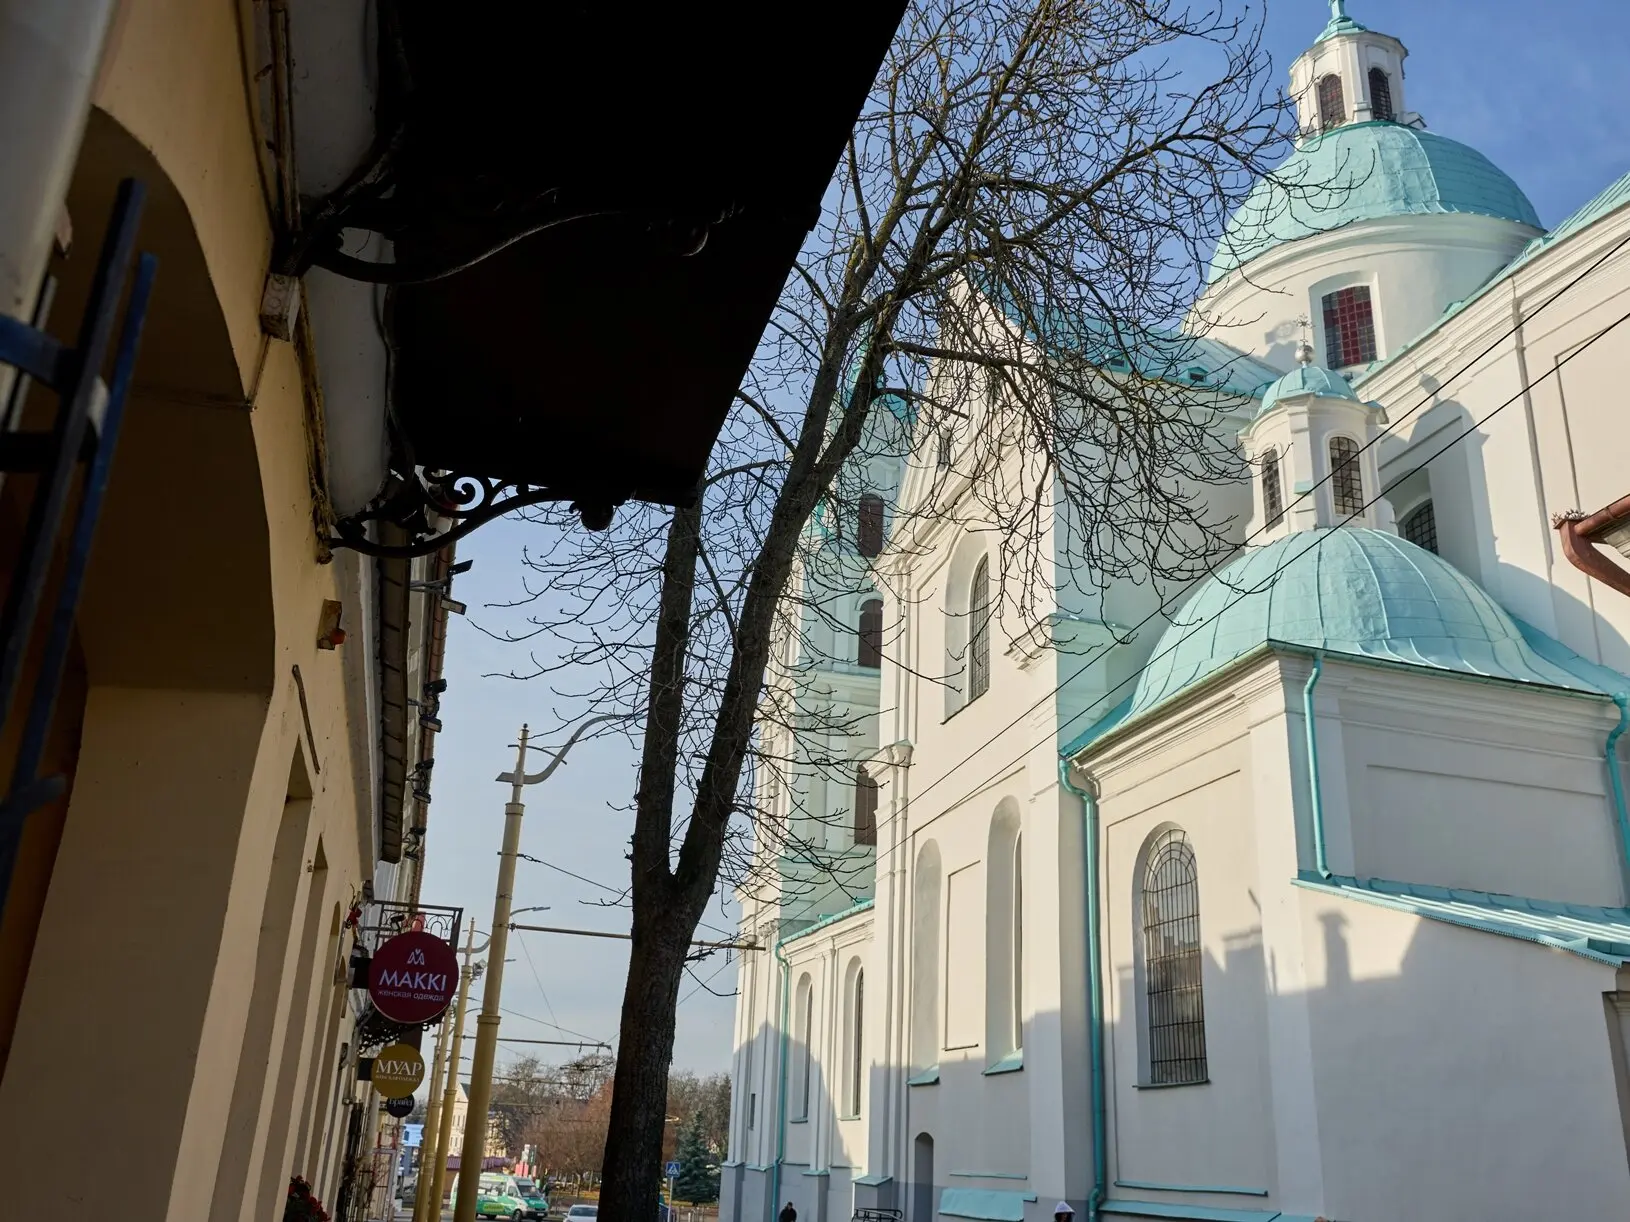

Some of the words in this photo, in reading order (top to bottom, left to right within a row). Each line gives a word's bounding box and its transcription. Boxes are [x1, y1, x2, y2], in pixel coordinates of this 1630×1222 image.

[379, 969, 447, 991] MAKKI
[377, 989, 412, 998] женская
[413, 992, 445, 1001] одежда
[376, 1059, 423, 1076] МУАР
